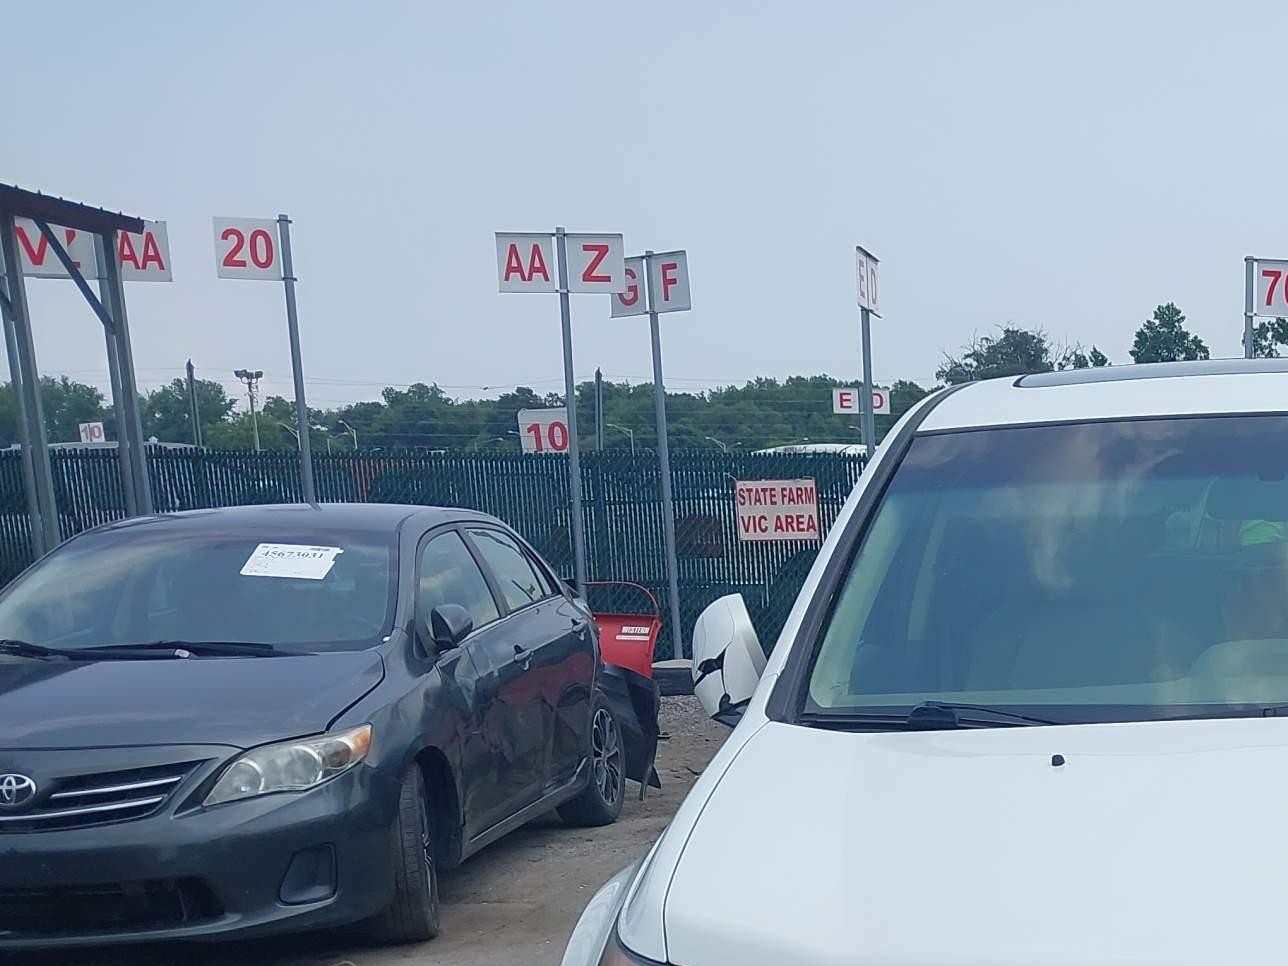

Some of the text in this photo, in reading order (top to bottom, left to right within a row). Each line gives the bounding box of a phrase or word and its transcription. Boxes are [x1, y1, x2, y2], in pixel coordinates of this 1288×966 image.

[118, 230, 165, 271] AA
[220, 228, 274, 269] 20
[504, 243, 550, 282] AA
[582, 244, 612, 282] Z
[618, 268, 639, 306] G
[660, 263, 678, 301] F
[839, 392, 852, 409] E
[527, 421, 569, 452] 10
[738, 486, 815, 506] STATE FARM
[740, 514, 816, 534] VIC AREA
